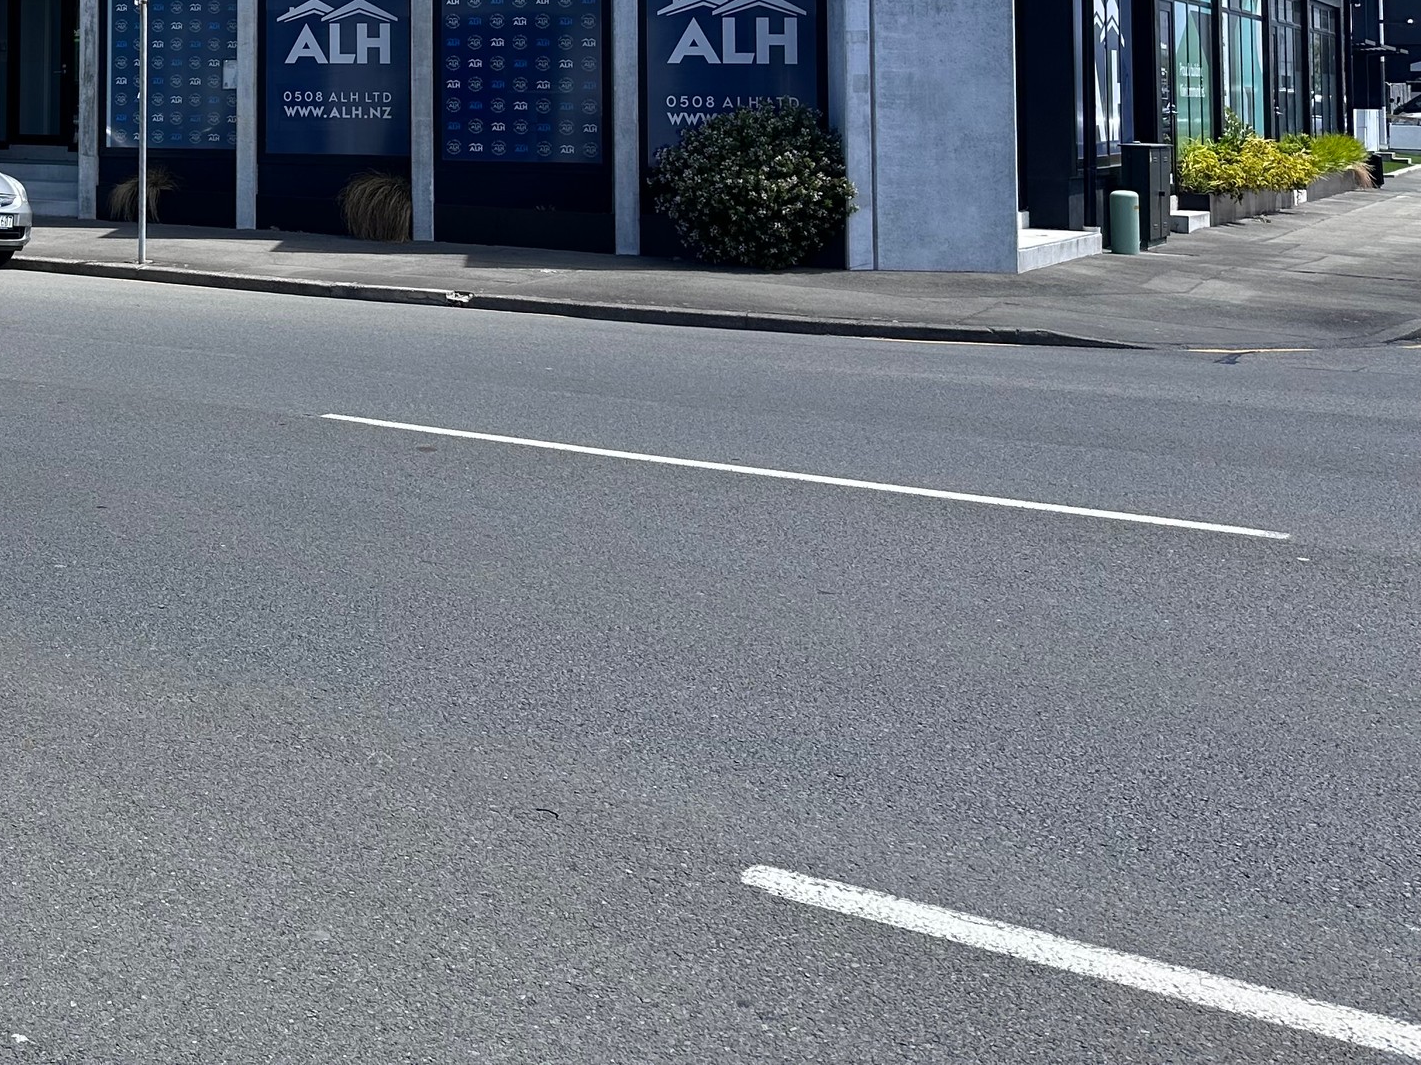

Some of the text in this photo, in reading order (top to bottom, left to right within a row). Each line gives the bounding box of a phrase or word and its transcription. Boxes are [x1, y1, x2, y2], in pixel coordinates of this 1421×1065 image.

[284, 22, 391, 64] ALH
[666, 16, 798, 64] ALH
[284, 91, 392, 103] 0508 ALH LTD
[666, 95, 715, 108] 0508
[284, 106, 392, 119] WWW.ALH.NZ
